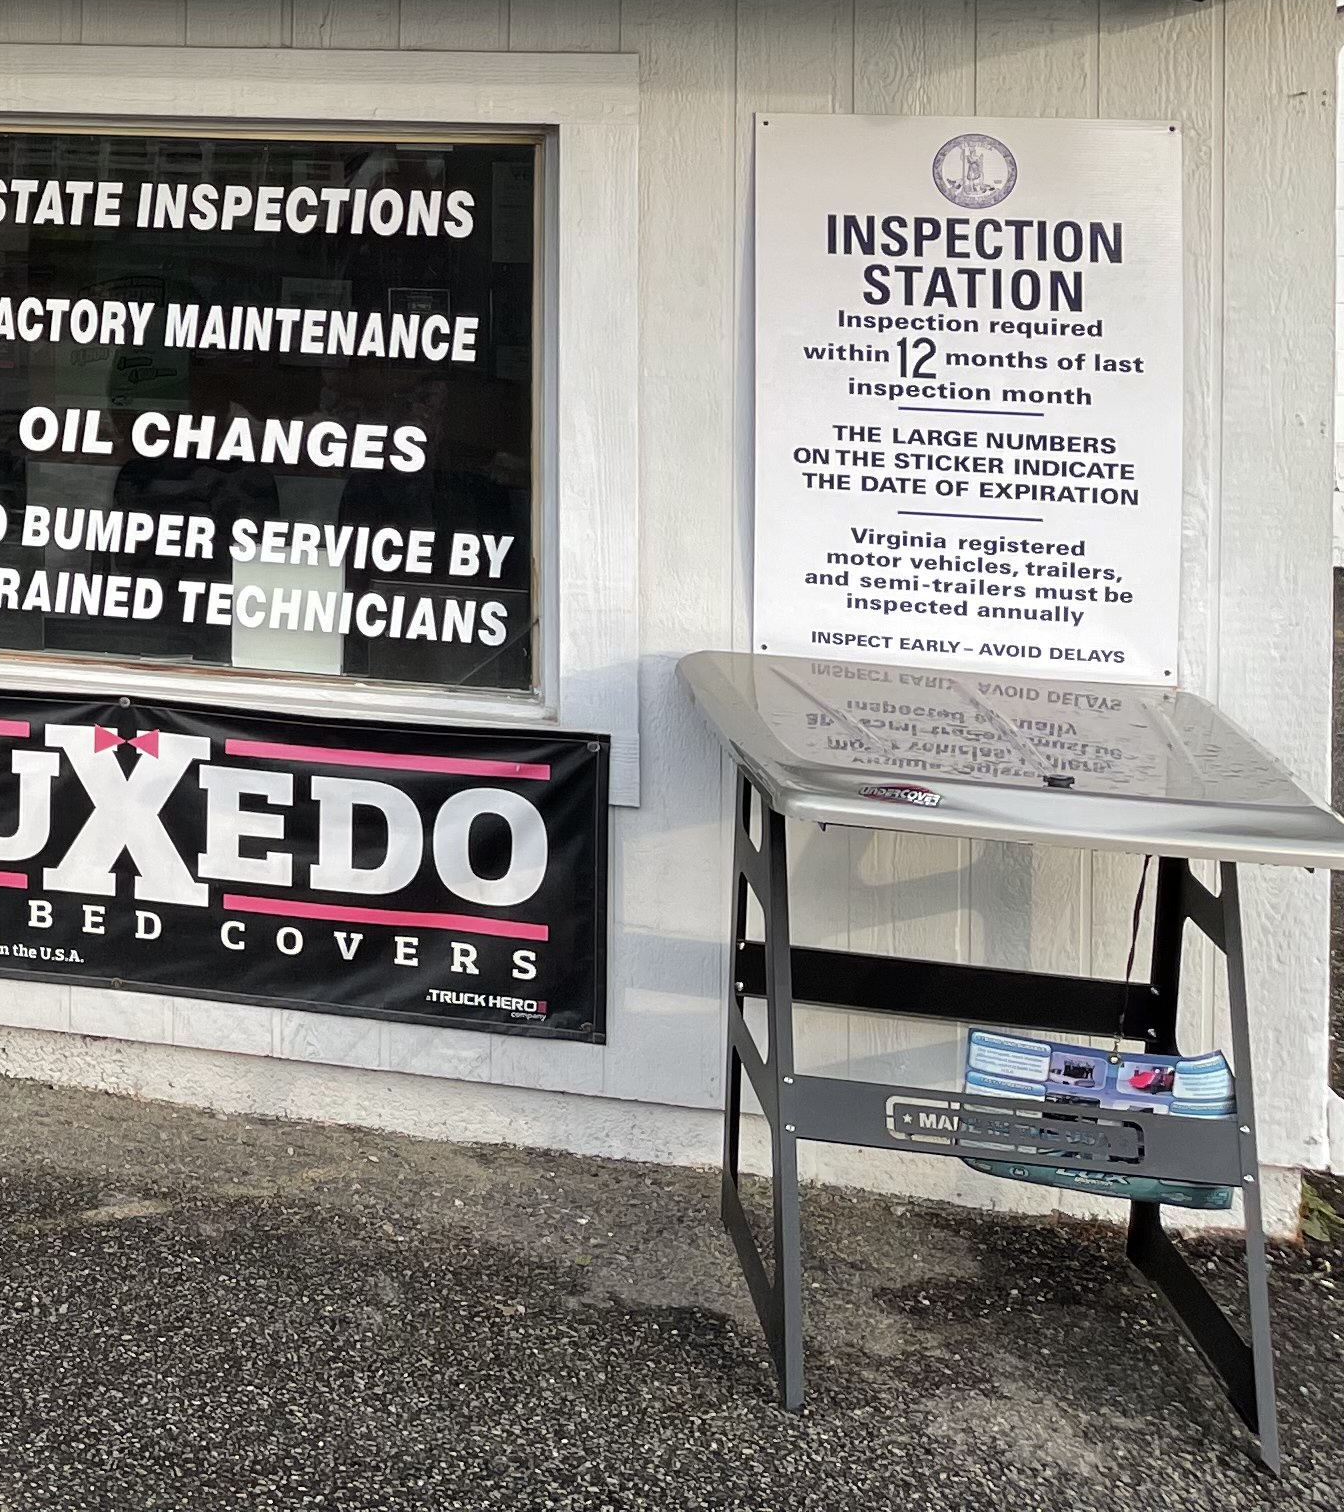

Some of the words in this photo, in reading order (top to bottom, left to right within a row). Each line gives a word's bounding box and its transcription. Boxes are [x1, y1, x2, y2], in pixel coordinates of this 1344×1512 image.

[137, 181, 476, 239] INSPECTIONS
[827, 214, 1123, 264] INSPECTION
[862, 264, 1084, 312] STATION
[164, 304, 480, 363] MAINTENANCE
[838, 311, 979, 335] Inspection
[989, 319, 1103, 339] required
[803, 344, 890, 364] within
[897, 337, 937, 379] 12
[945, 351, 1048, 370] months
[1057, 353, 1086, 371] of
[1094, 354, 1144, 374] last
[848, 379, 990, 402] inspection
[1002, 385, 1092, 406] month
[19, 406, 113, 456] OIL
[131, 412, 428, 473] CHANGES
[833, 425, 882, 444] THE
[892, 428, 978, 448] LARGE
[986, 432, 1117, 454] NUMBERS
[793, 447, 830, 466] ON
[836, 449, 885, 469] THE
[894, 453, 1004, 475] STICKER
[1014, 458, 1135, 481] INDICATE
[803, 472, 851, 492] THE
[861, 476, 927, 496] DATE
[935, 479, 969, 498] OF
[979, 482, 1140, 506] EXPIRATION
[21, 502, 214, 560] BUMPER
[229, 518, 434, 574] SERVICE
[449, 532, 515, 580] BY
[851, 527, 947, 550] Virginia
[957, 533, 1086, 557] registered
[827, 551, 902, 570] motor
[910, 553, 1018, 577] vehicles,
[1026, 560, 1123, 583] trailers,
[804, 571, 850, 588] and
[859, 573, 1026, 599] semi-trailers
[1035, 583, 1098, 602] must
[1104, 587, 1134, 605] be
[178, 582, 509, 648] TECHNICIANS
[846, 595, 968, 618] inspected
[977, 602, 1084, 627] annually
[811, 631, 892, 649] INSPECT
[899, 636, 961, 654] EARLY
[979, 642, 1042, 660] AVOID
[1049, 647, 1126, 665] DELAYS
[13, 943, 37, 960] the
[40, 946, 85, 963] U.S.A.
[27, 899, 163, 943] BED
[220, 921, 539, 983] COVERS
[429, 989, 486, 1006] TRUCK
[488, 996, 537, 1012] HERO
[511, 1012, 546, 1021] company
